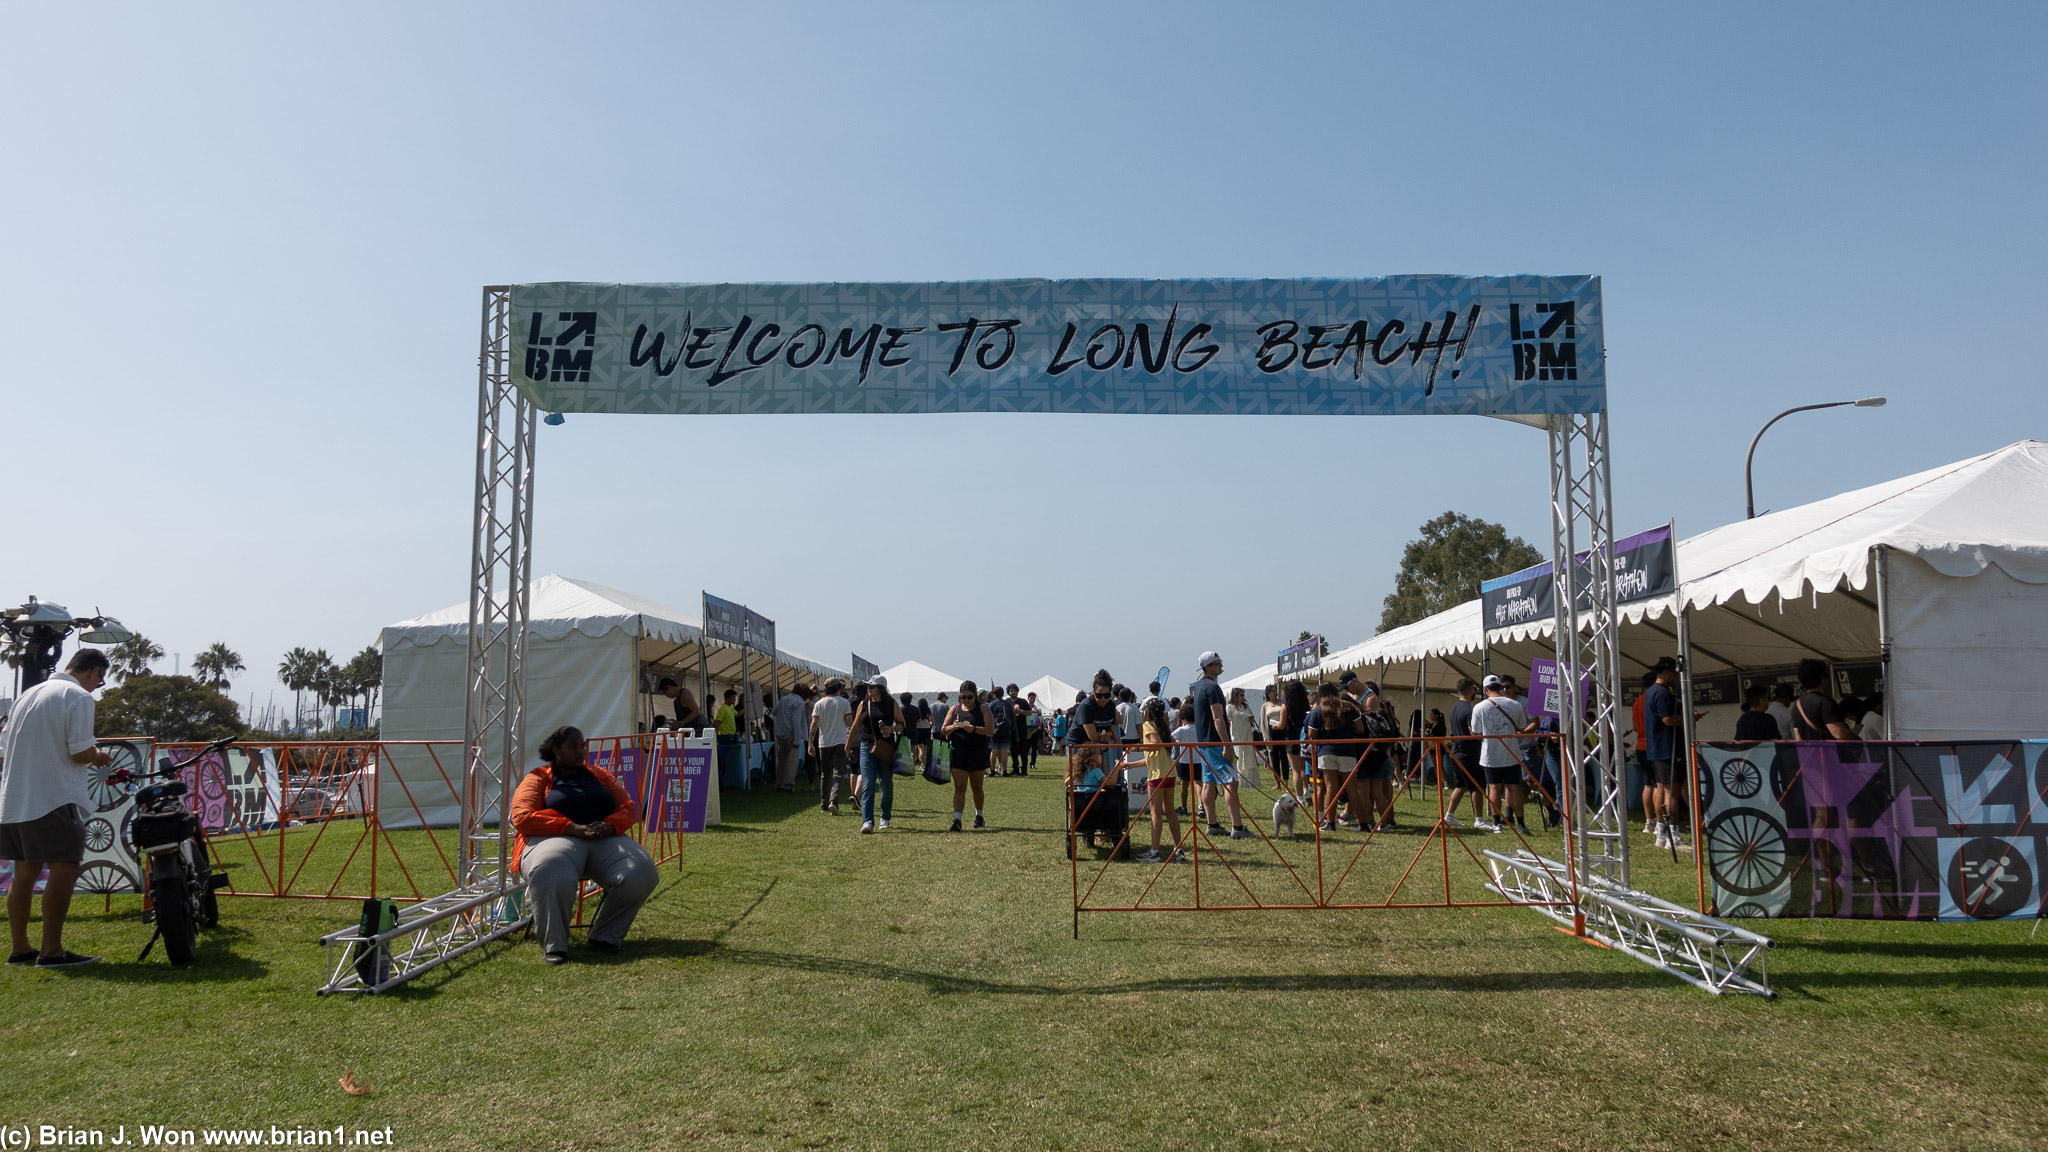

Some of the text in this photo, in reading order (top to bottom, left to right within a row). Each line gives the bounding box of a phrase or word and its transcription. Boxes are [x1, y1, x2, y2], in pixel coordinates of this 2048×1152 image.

[525, 349, 592, 383] BM
[629, 300, 1481, 398] WELCOME TO LONG BEACH!
[1513, 342, 1578, 381] BM
[1615, 564, 1648, 601] ARATHON
[1538, 665, 1556, 676] LOOK
[1539, 675, 1552, 684] BIB
[688, 756, 705, 766] YOUR
